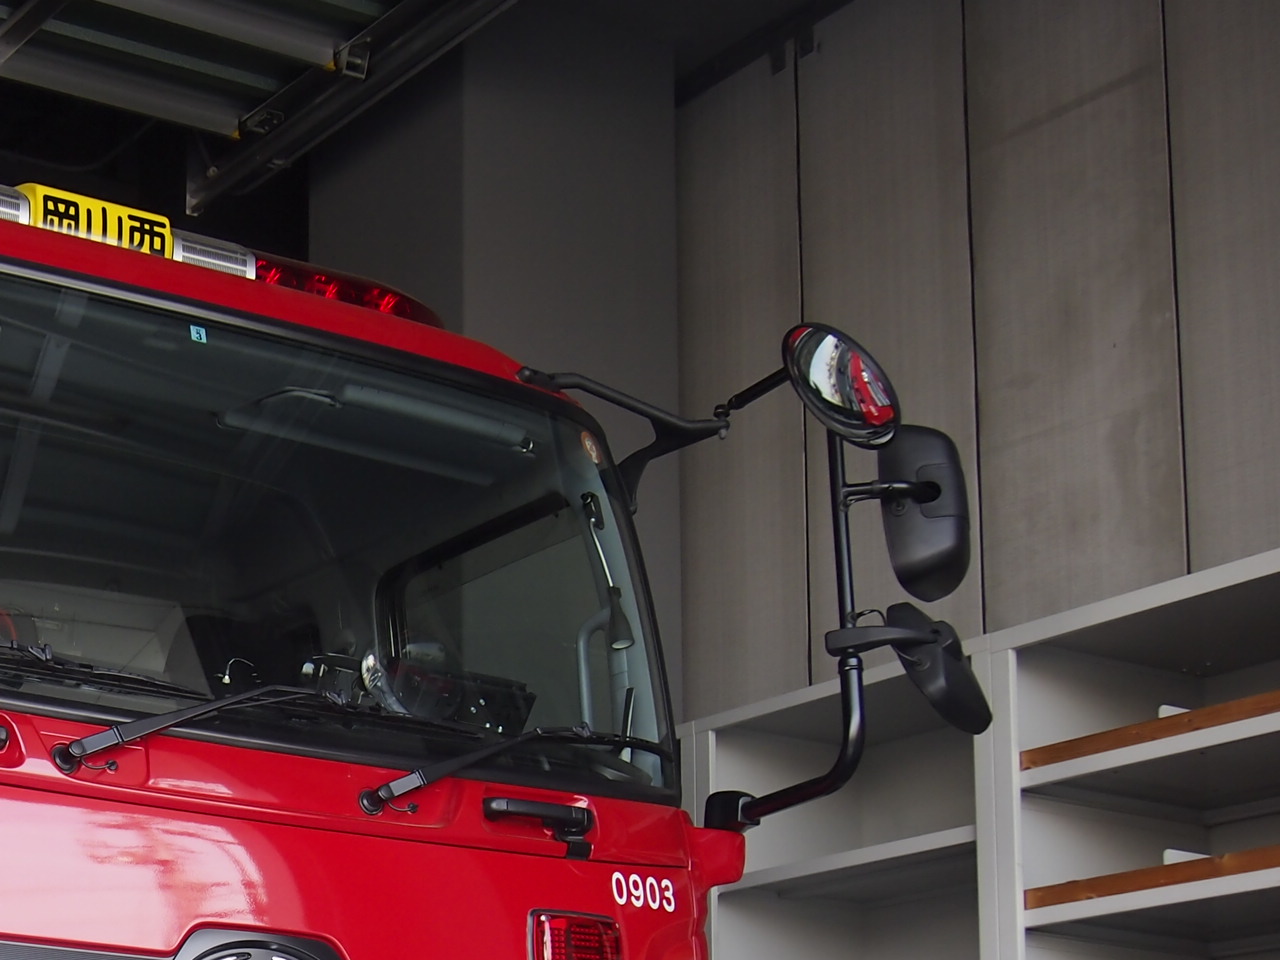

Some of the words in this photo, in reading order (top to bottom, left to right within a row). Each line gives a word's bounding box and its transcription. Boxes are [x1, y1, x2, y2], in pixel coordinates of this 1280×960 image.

[42, 194, 167, 259] 岡山西
[611, 871, 675, 913] 0903
